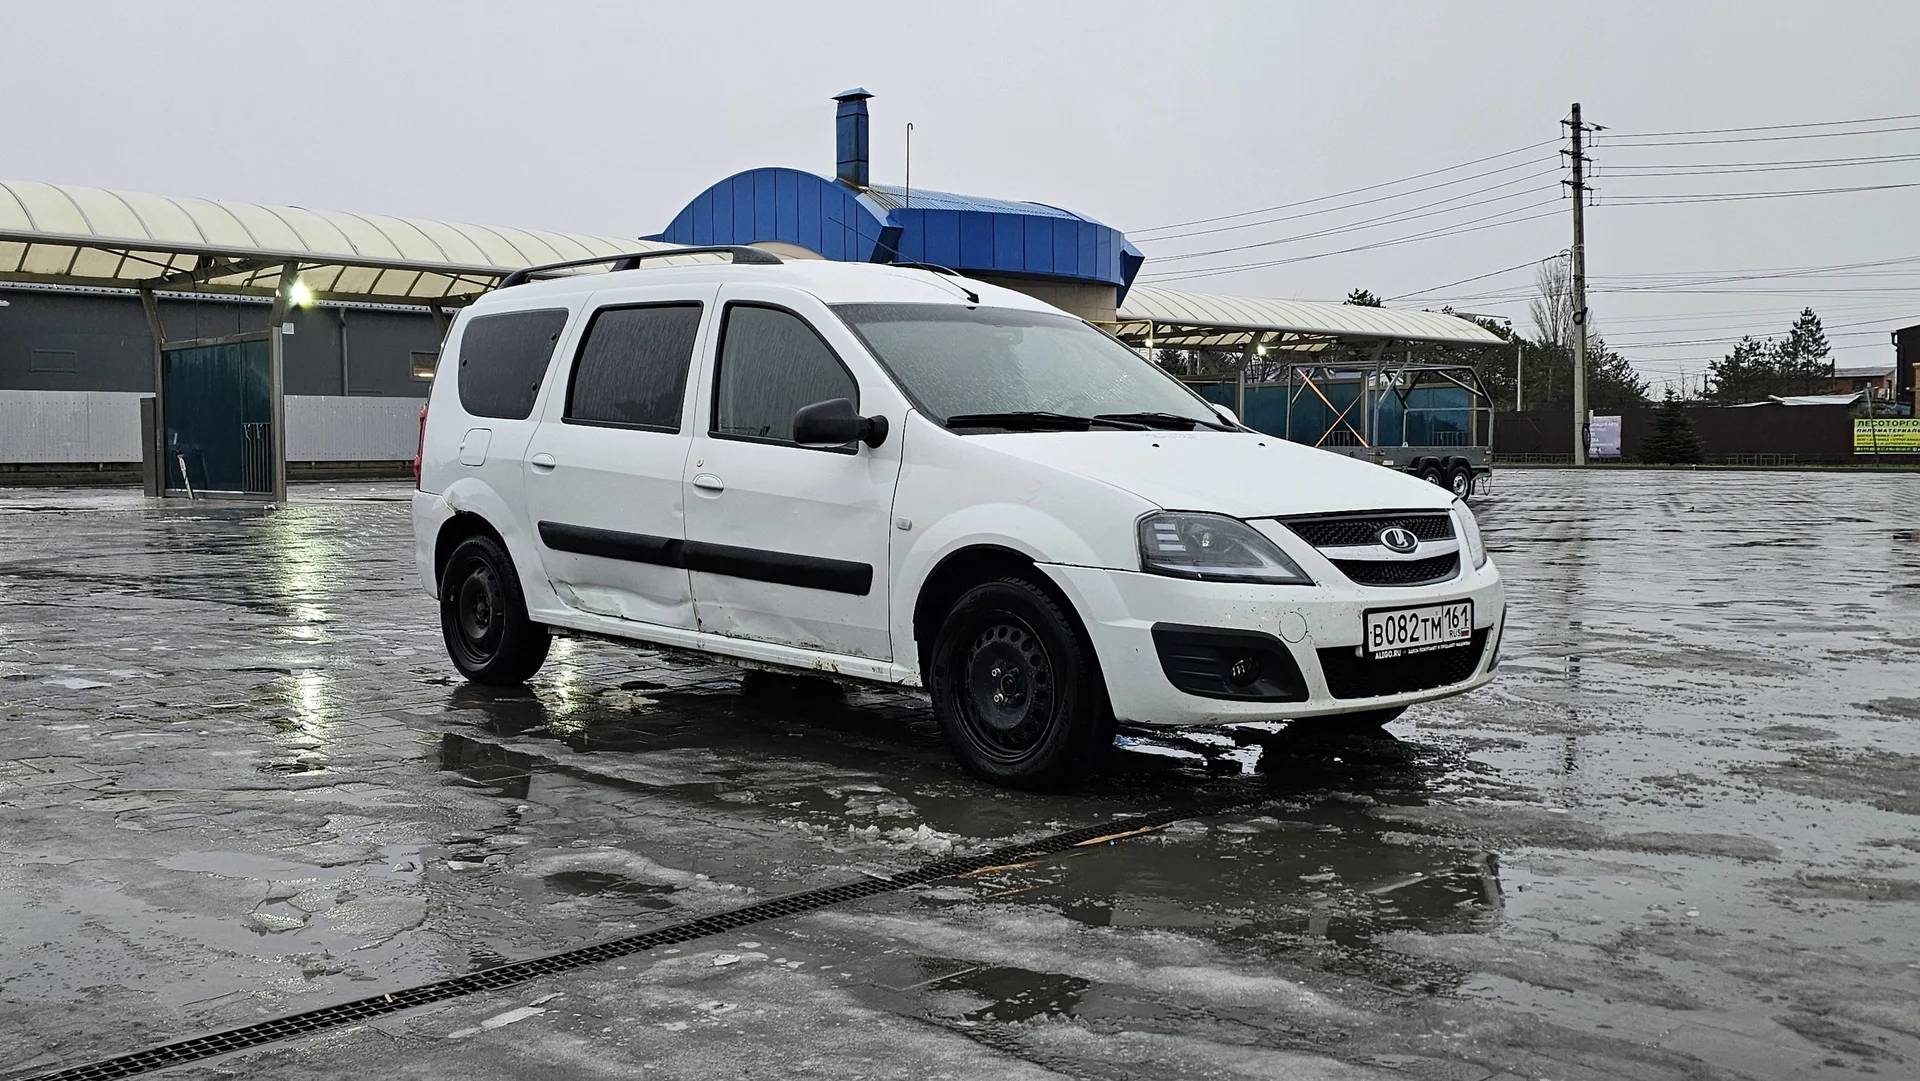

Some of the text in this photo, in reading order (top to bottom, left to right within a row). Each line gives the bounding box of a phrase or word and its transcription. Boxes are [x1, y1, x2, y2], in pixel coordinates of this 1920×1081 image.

[1373, 605, 1469, 647] В082ТМ 161
[1450, 629, 1461, 638] RUS
[1375, 649, 1402, 660] ALIGO.RU
